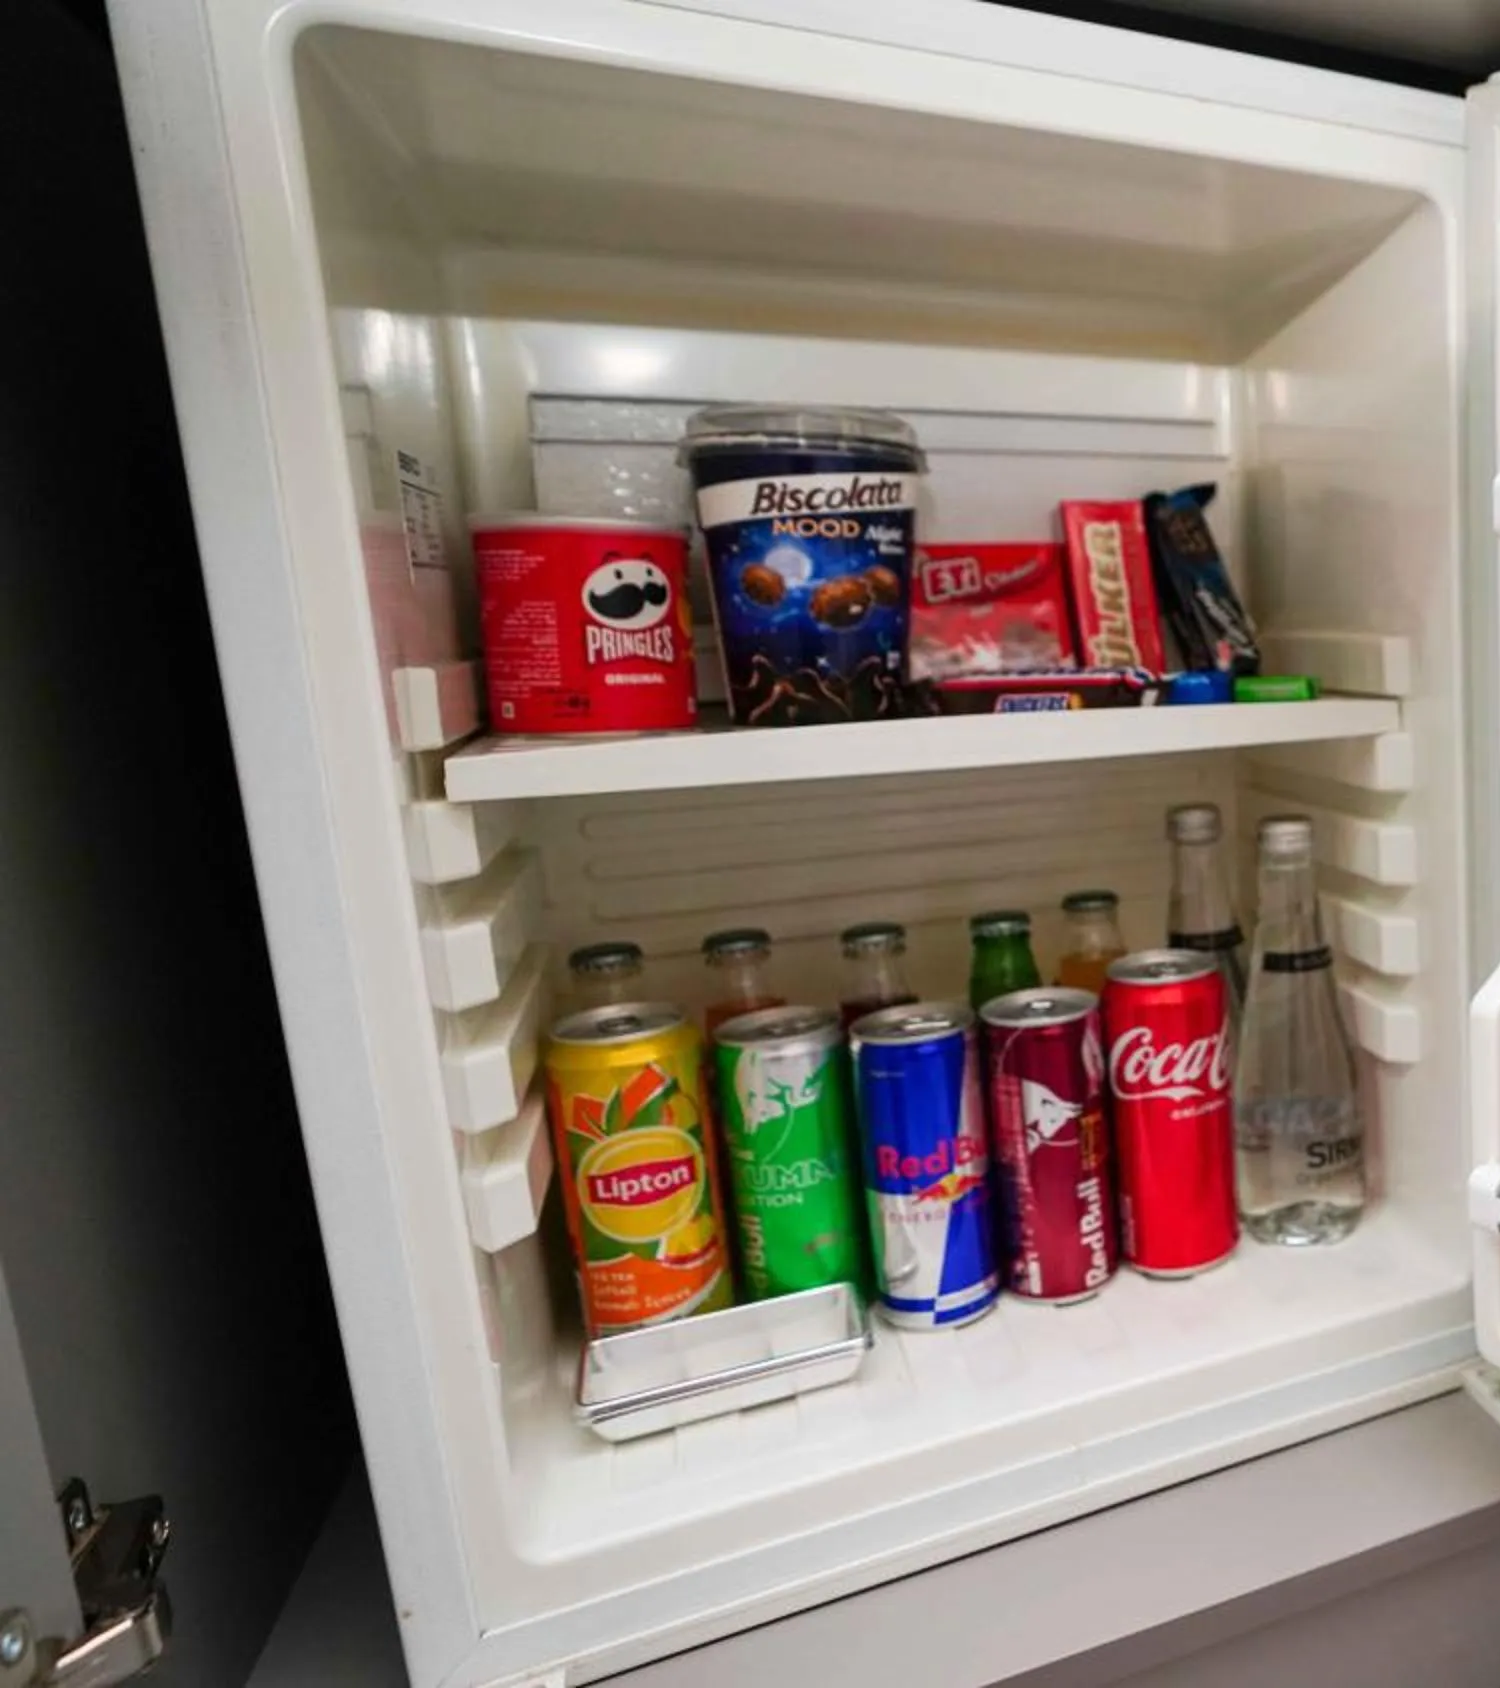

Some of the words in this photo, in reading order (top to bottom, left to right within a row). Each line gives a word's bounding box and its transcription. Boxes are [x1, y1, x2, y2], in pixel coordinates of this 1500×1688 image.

[750, 476, 903, 515] Biscolata
[772, 517, 862, 539] MOOD
[584, 624, 675, 665] PRINGLES
[876, 1137, 950, 1180] Red
[595, 1164, 691, 1201] Lipton
